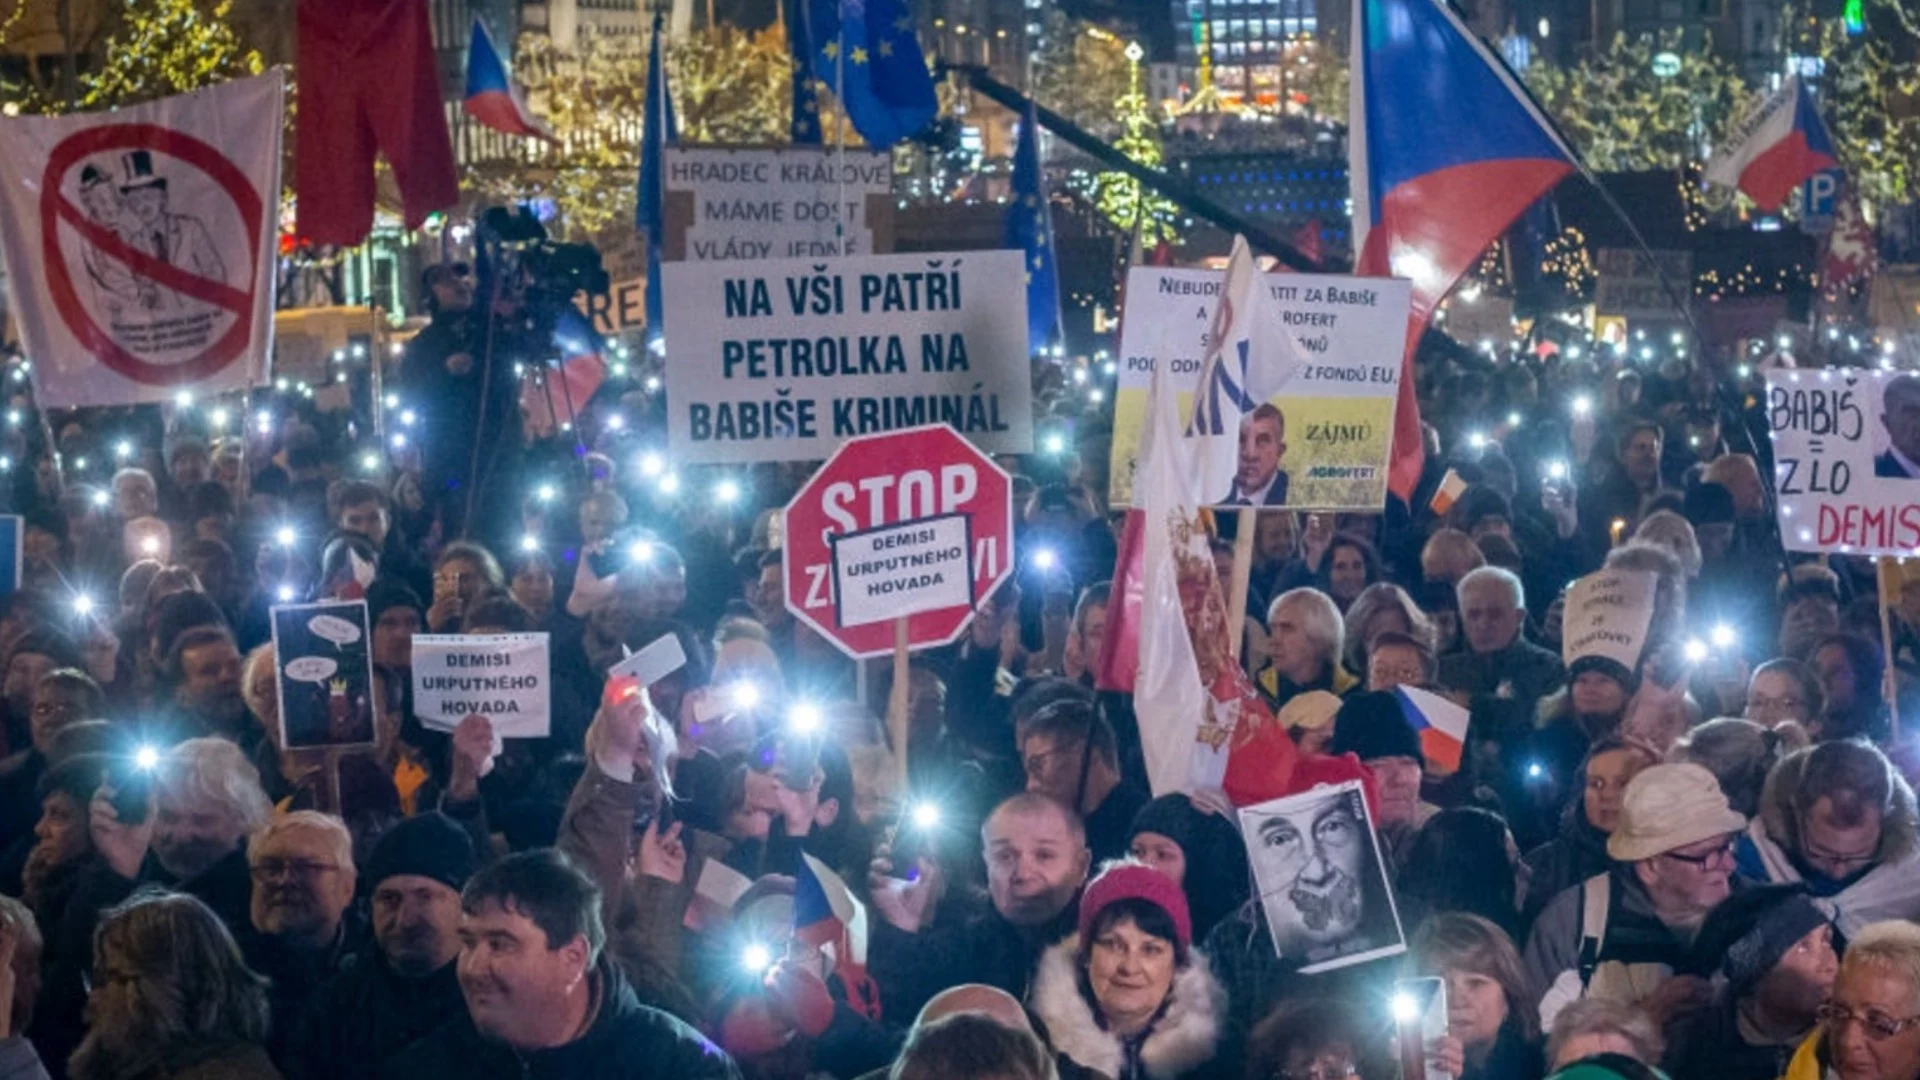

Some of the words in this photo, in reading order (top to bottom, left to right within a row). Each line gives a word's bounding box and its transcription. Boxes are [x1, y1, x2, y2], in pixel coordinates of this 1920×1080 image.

[671, 162, 768, 183] HRADEC
[781, 157, 889, 185] KRÁLOVÉ
[1811, 175, 1835, 211] P
[704, 199, 784, 222] MÁME
[694, 235, 772, 260] VLÁDY
[723, 277, 772, 318] NA
[786, 264, 843, 316] VŠI
[861, 258, 964, 313] PATŘÍ
[1304, 288, 1323, 302] ZA
[1282, 310, 1338, 328] ROFERT
[722, 334, 907, 379] PETROLKA
[921, 333, 970, 372] NA
[1304, 365, 1313, 380] Z
[1316, 364, 1367, 382] FONDŮ
[690, 387, 817, 441] BABIŠE
[833, 382, 1009, 437] KRIMINÁL
[1771, 377, 1864, 442] BABIŠ
[1305, 466, 1376, 479] AGROFERT
[820, 463, 978, 549] STOP
[872, 529, 936, 551] DEMISI
[847, 547, 962, 577] URPUTNÉHO
[867, 572, 944, 597] HOVADA
[446, 653, 511, 667] DEMISI
[422, 675, 538, 691] URPUTNÉHO
[441, 699, 520, 715] HOVADA
